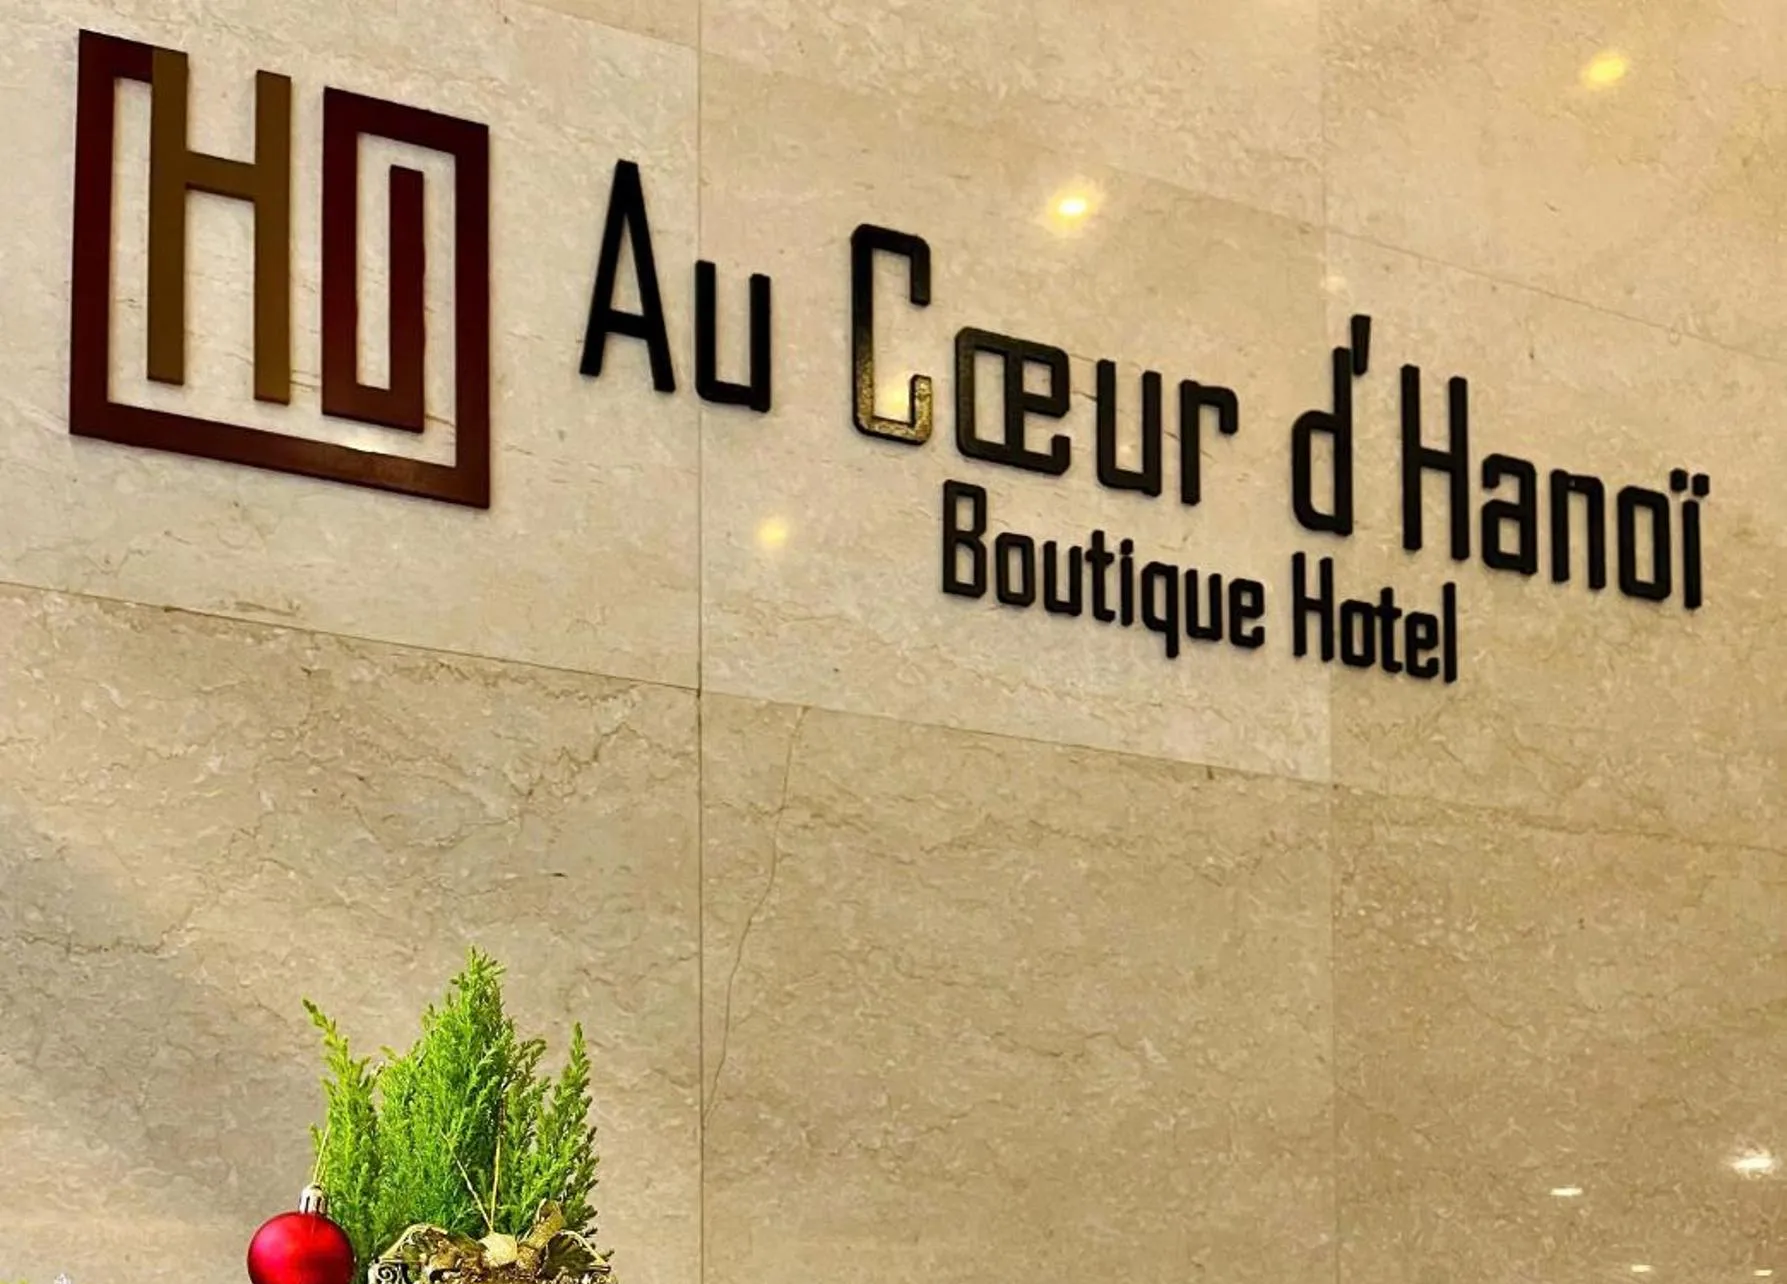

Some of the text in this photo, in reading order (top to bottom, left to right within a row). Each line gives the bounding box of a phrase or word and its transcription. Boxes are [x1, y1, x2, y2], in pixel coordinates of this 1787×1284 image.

[579, 159, 771, 413] Au
[1291, 314, 1710, 611] d'Hanoï
[942, 479, 1458, 685] Boutique Hotel
